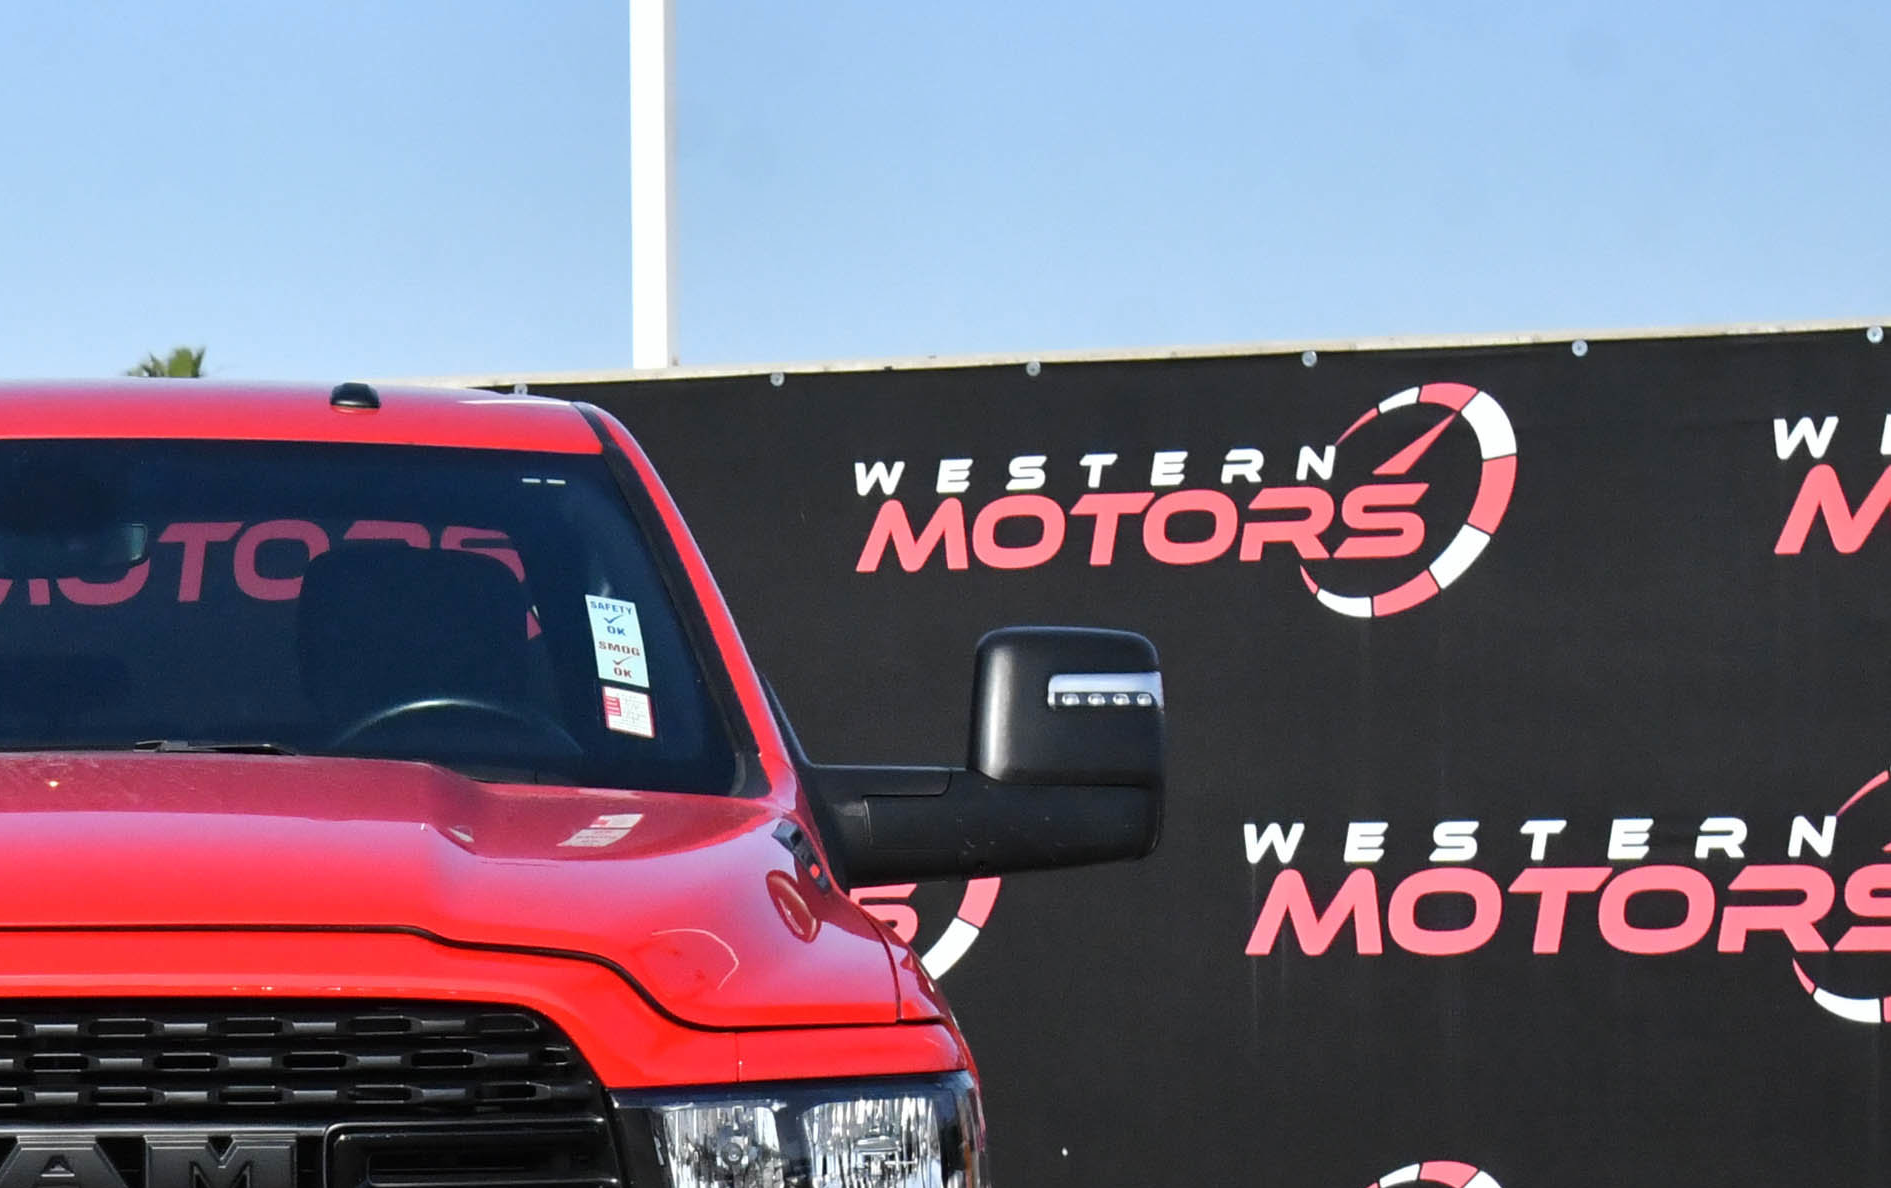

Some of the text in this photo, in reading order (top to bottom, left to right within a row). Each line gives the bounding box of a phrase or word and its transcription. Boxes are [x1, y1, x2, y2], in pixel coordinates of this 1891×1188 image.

[855, 445, 1336, 495] WESTERN
[856, 482, 1431, 573] MOTORS
[590, 601, 633, 616] SAFETY
[607, 625, 626, 636] OK
[598, 641, 641, 657] SMOG
[614, 667, 633, 678] OK
[1243, 816, 1837, 864] WESTERN
